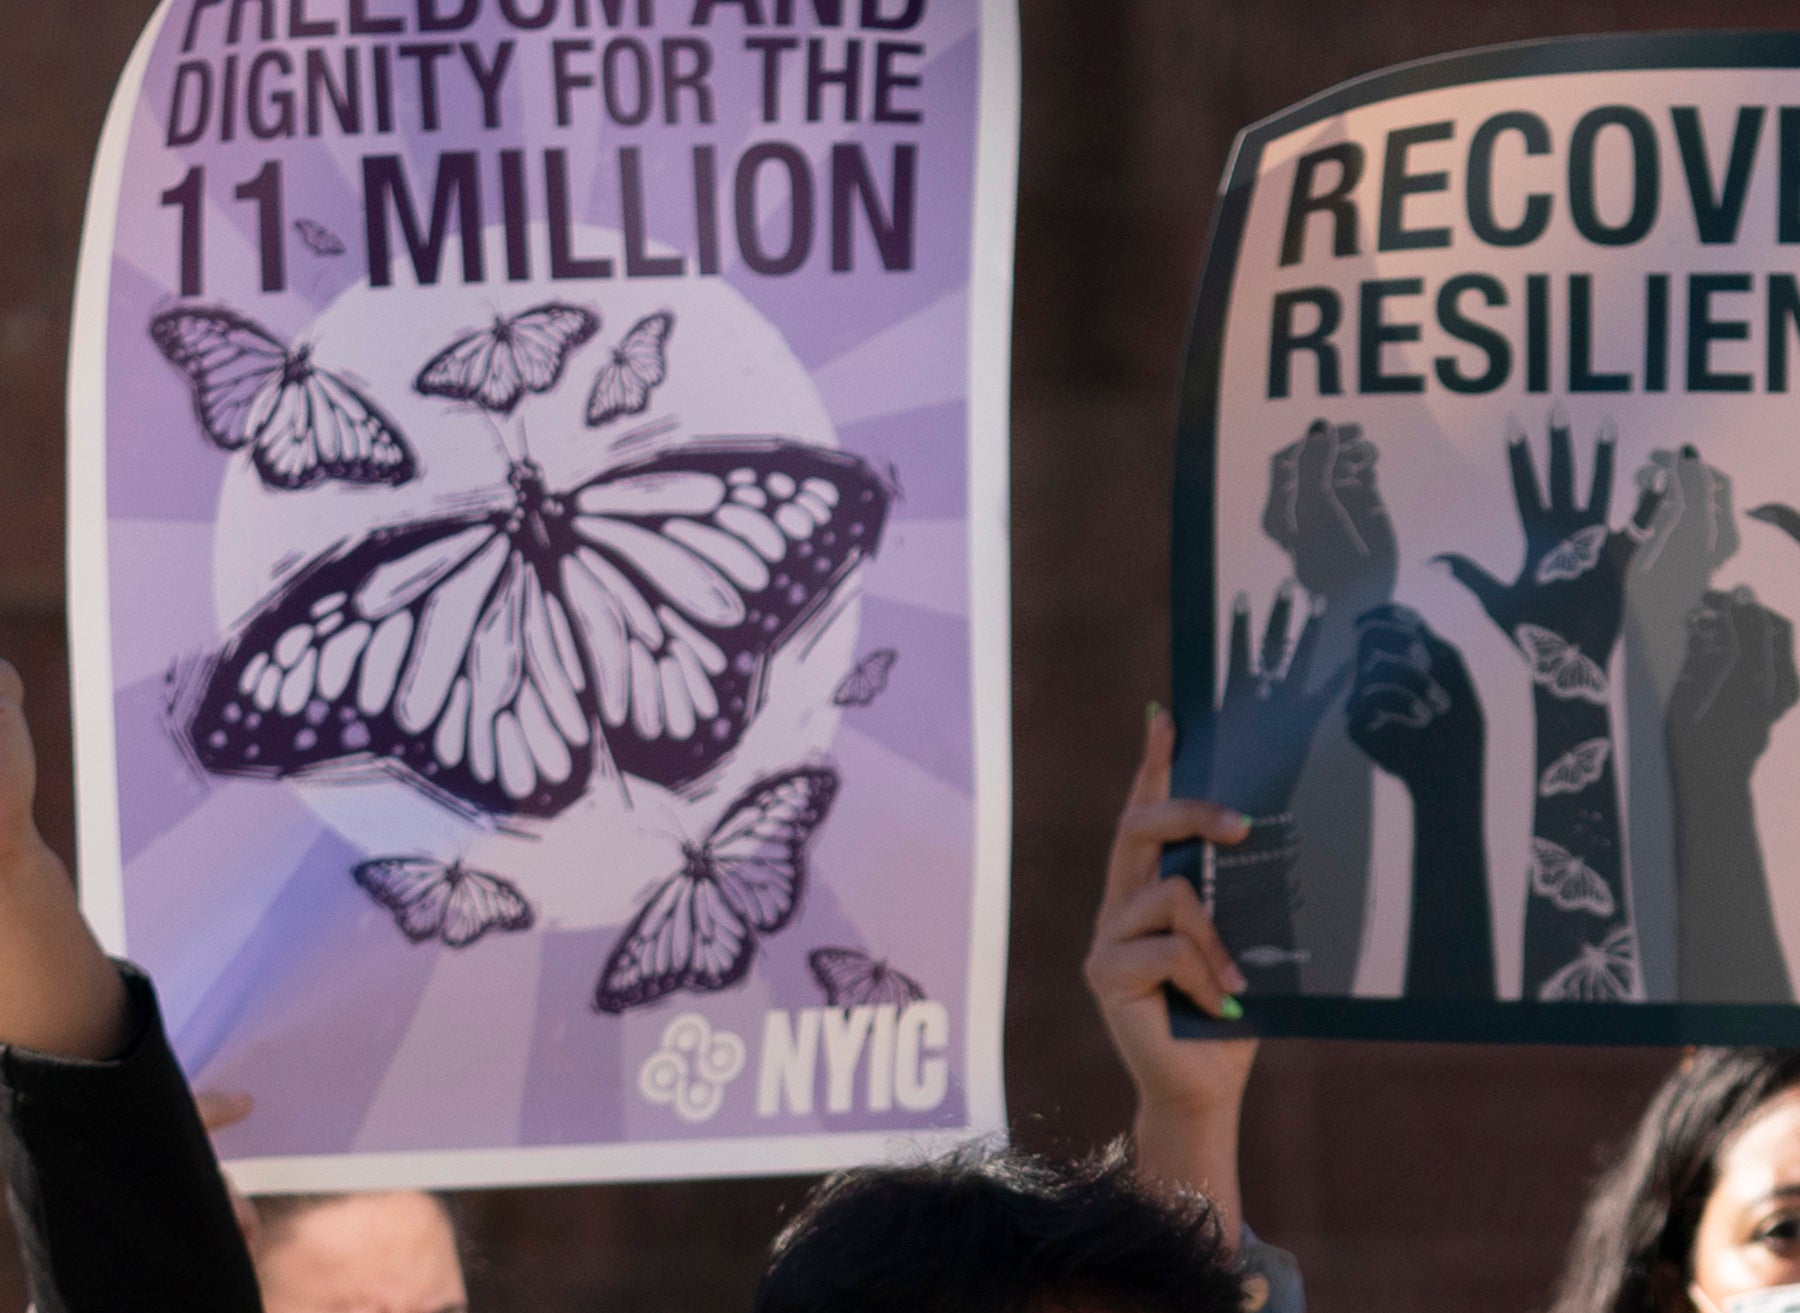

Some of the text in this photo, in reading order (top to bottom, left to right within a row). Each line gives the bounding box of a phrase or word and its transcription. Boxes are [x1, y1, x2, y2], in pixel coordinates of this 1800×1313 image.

[165, 36, 926, 148] DIGNITY FOR THE
[160, 141, 920, 299] 11 MILLION
[755, 999, 950, 1118] NYIC
